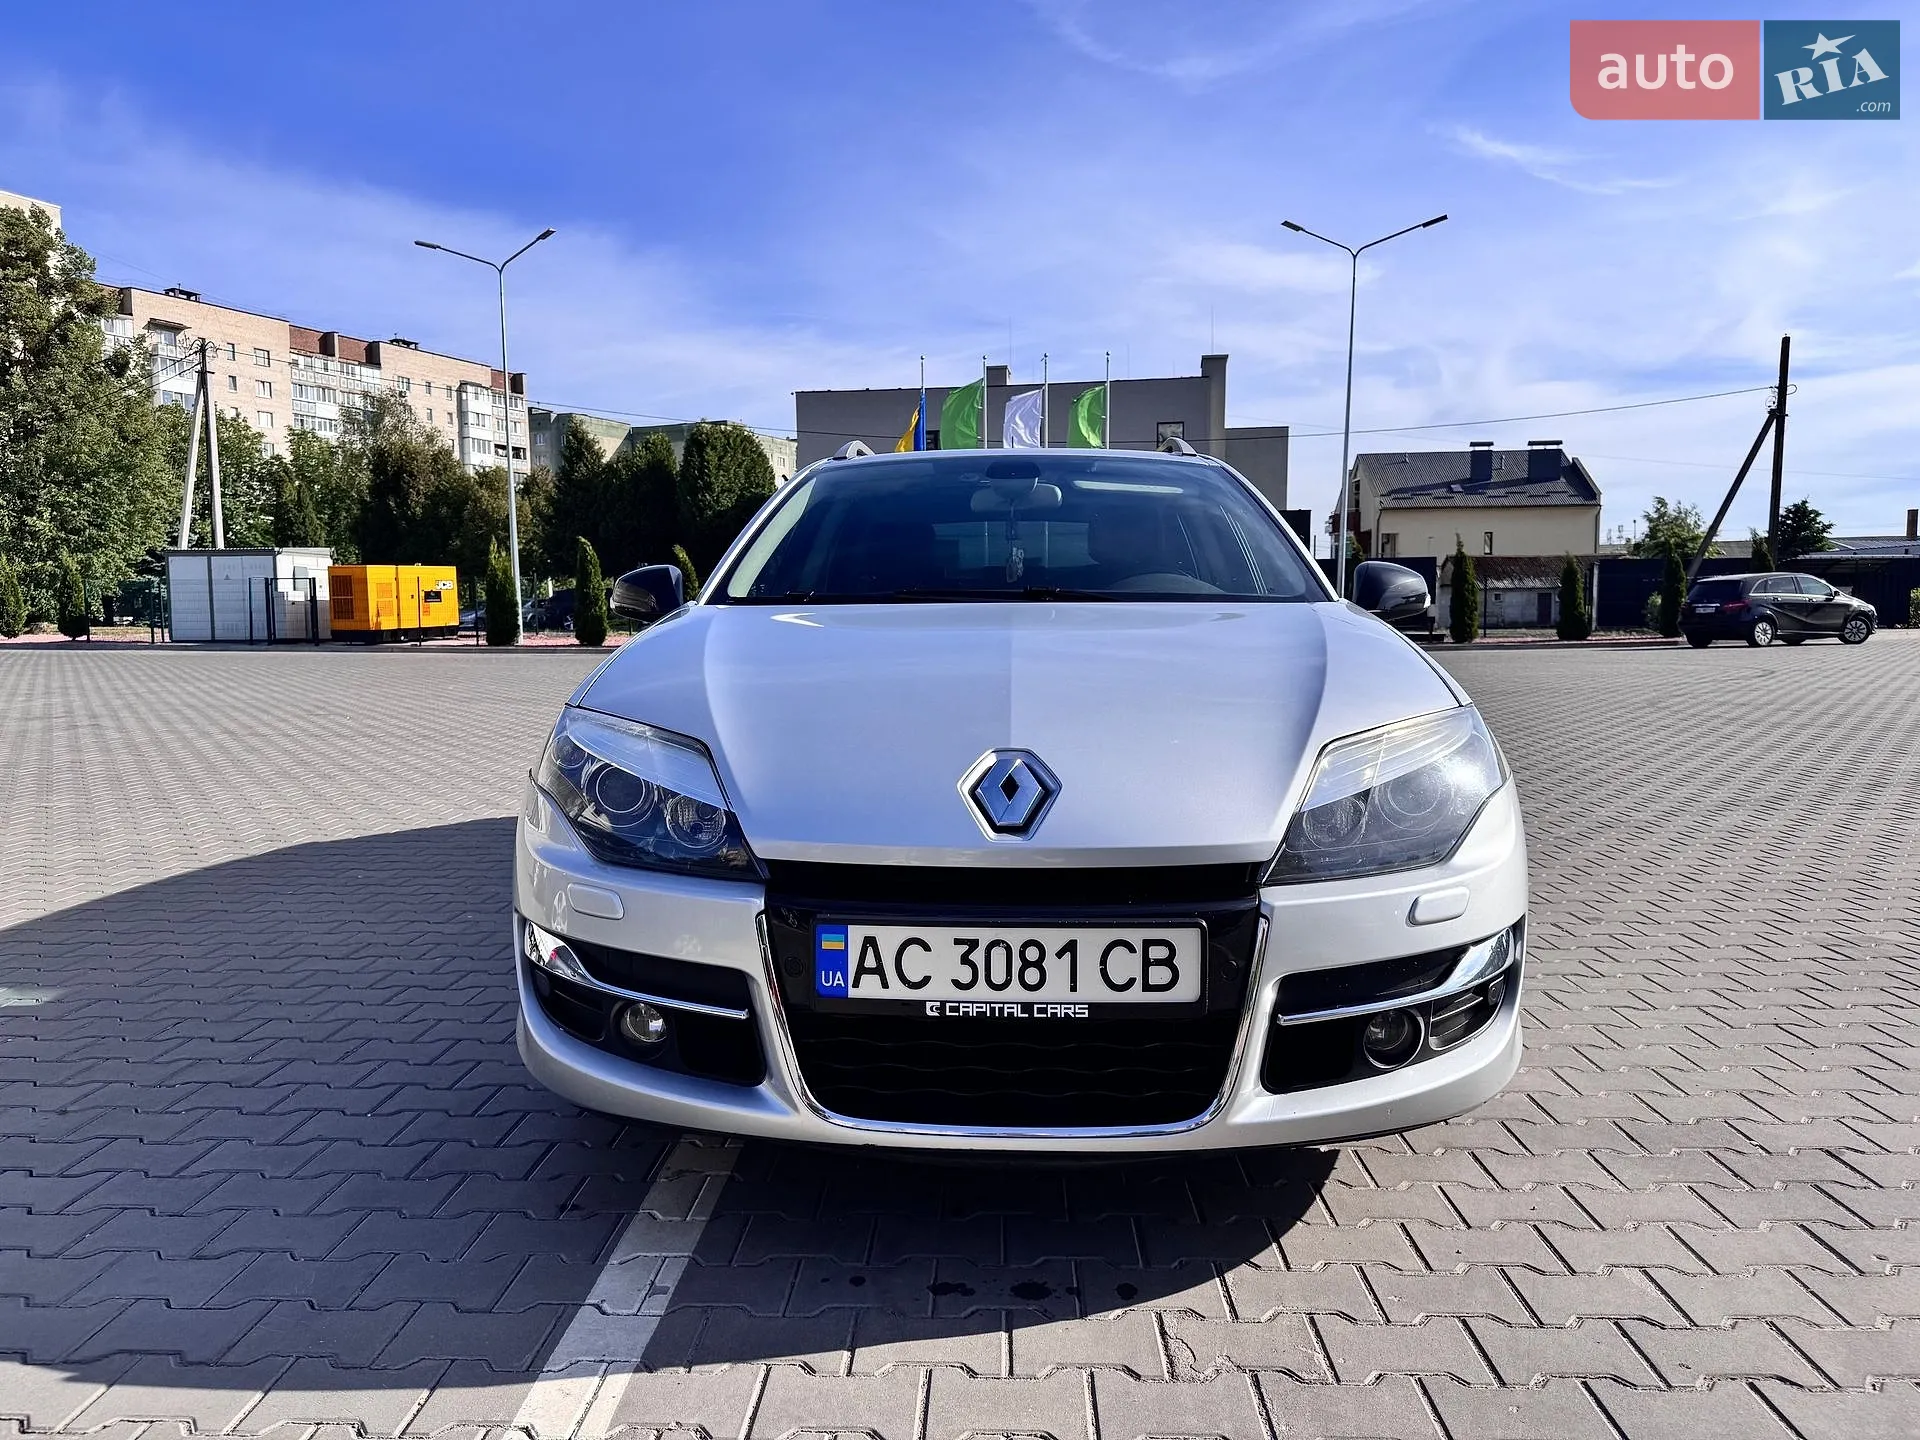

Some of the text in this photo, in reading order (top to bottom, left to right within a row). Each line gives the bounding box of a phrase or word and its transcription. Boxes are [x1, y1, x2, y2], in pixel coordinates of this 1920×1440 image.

[852, 935, 1180, 993] AC 3081 CB
[821, 971, 845, 987] UA
[946, 1003, 1089, 1018] CAPITAL CARS
